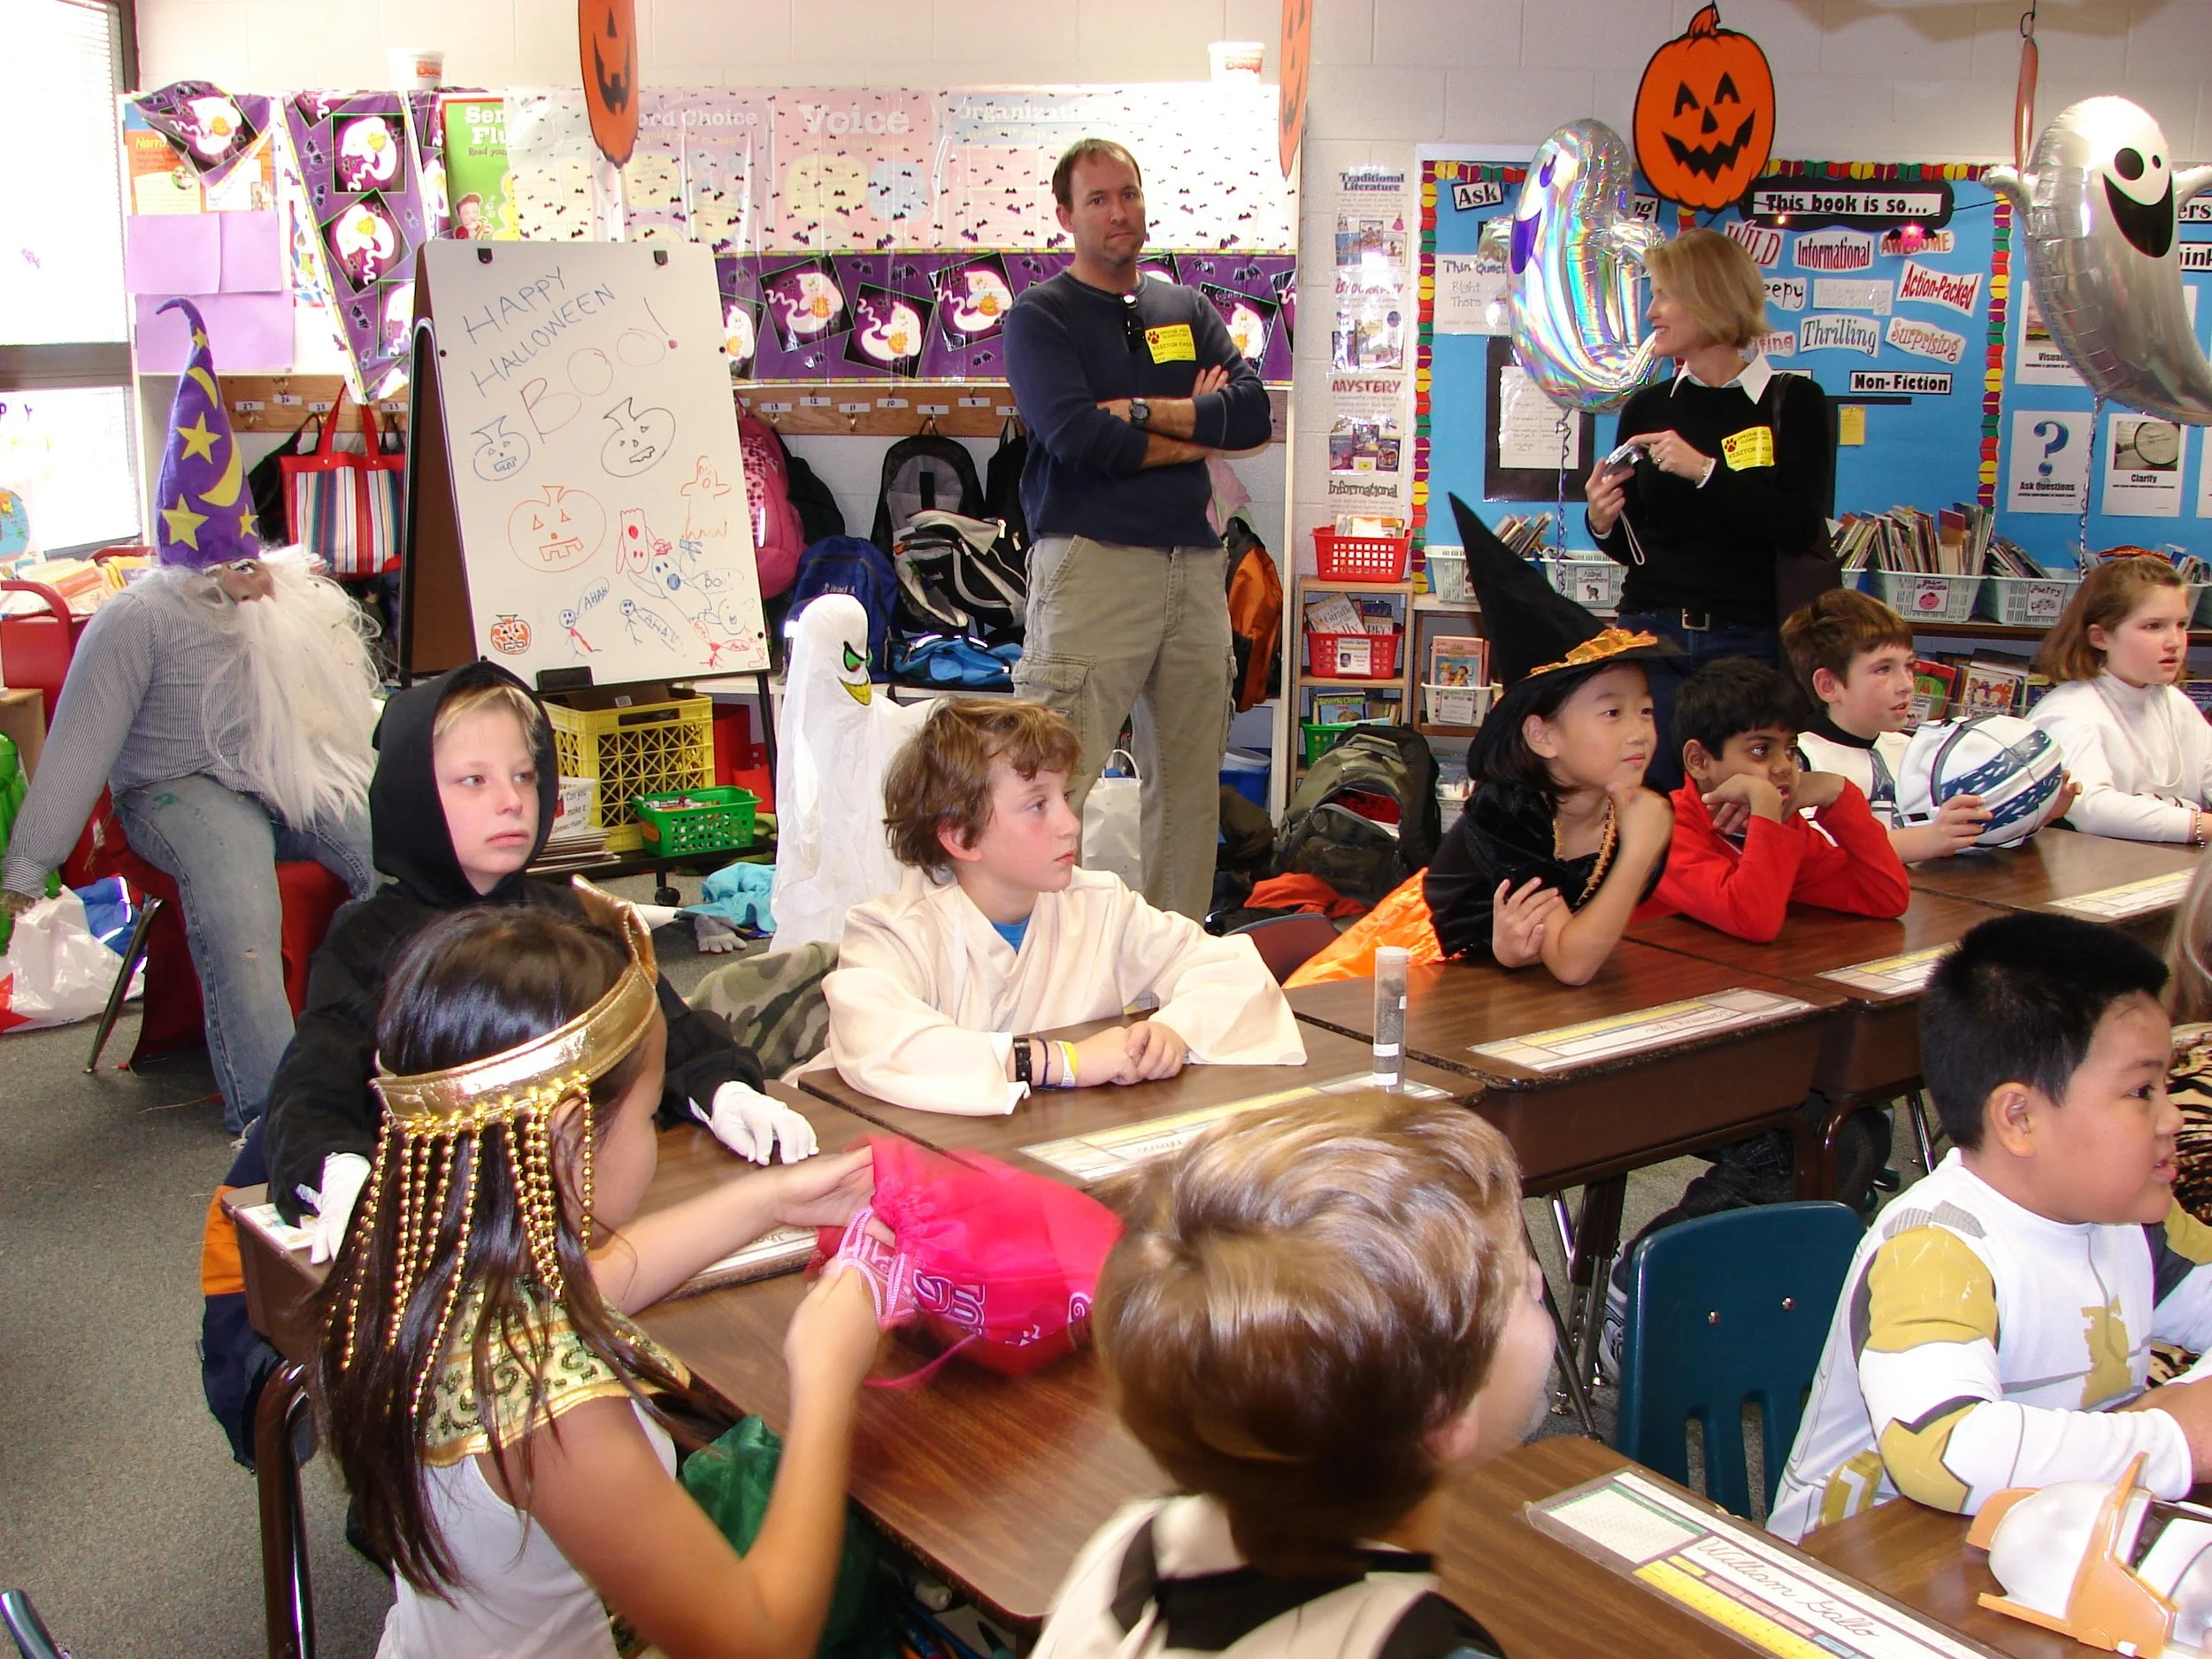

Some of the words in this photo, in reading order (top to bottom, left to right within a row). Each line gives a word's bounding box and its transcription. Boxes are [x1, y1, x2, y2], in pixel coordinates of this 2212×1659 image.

[638, 109, 674, 126] ord
[682, 109, 758, 126] Choice
[798, 104, 910, 134] Voice
[1339, 172, 1405, 183] Traditional
[1343, 181, 1401, 191] Literature
[1458, 184, 1498, 206] Ask
[1766, 194, 1803, 212] This
[1812, 194, 1857, 213] book
[1863, 195, 1878, 213] is
[1886, 199, 1928, 214] so...
[1881, 232, 1951, 255] AWEOME
[1798, 238, 1870, 270] Informational
[1763, 282, 1804, 309] eepy
[1900, 265, 1976, 311] Action-Packed
[463, 266, 565, 345] HAPPY
[471, 283, 616, 398] HALLOWEEN
[1803, 319, 1878, 355] Thrilling
[1891, 320, 1959, 362] Surprising
[519, 297, 679, 445] BOO!
[1332, 379, 1402, 394] MYSTERY
[1893, 374, 1948, 392] Fiction
[1727, 446, 1756, 459] VISITOR
[2019, 481, 2034, 490] Ask
[2036, 482, 2075, 491] Questions
[2131, 473, 2157, 484] Clarify
[1328, 480, 1398, 498] Informational
[2030, 585, 2063, 597] Poetry
